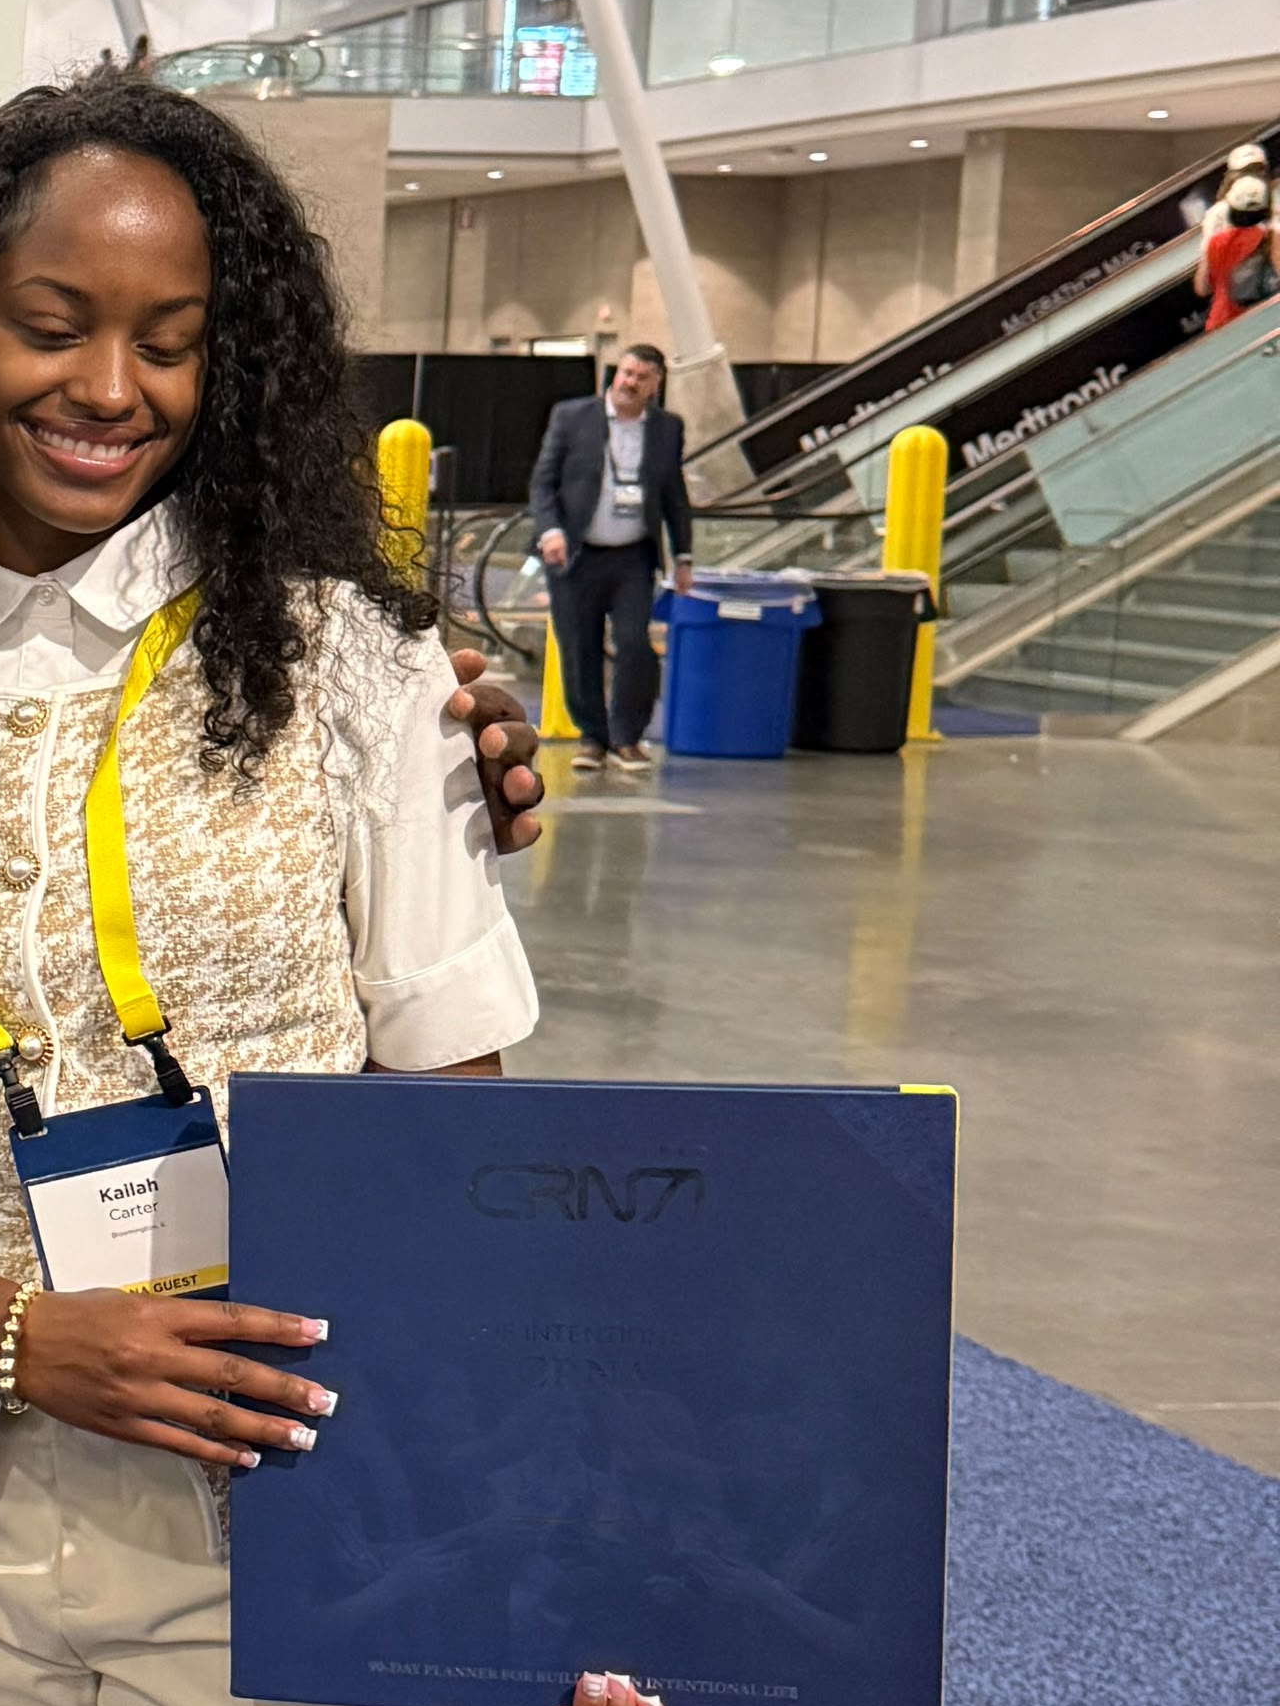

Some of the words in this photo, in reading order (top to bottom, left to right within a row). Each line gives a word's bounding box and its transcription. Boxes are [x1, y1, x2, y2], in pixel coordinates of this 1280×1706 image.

[961, 362, 1130, 469] Medtronic
[99, 1178, 159, 1203] Kailah
[109, 1201, 159, 1220] Carter
[153, 1274, 198, 1293] GUEST
[423, 1664, 500, 1680] PLANNER
[502, 1670, 533, 1683] FOR
[646, 1677, 758, 1697] INTENTIONAL
